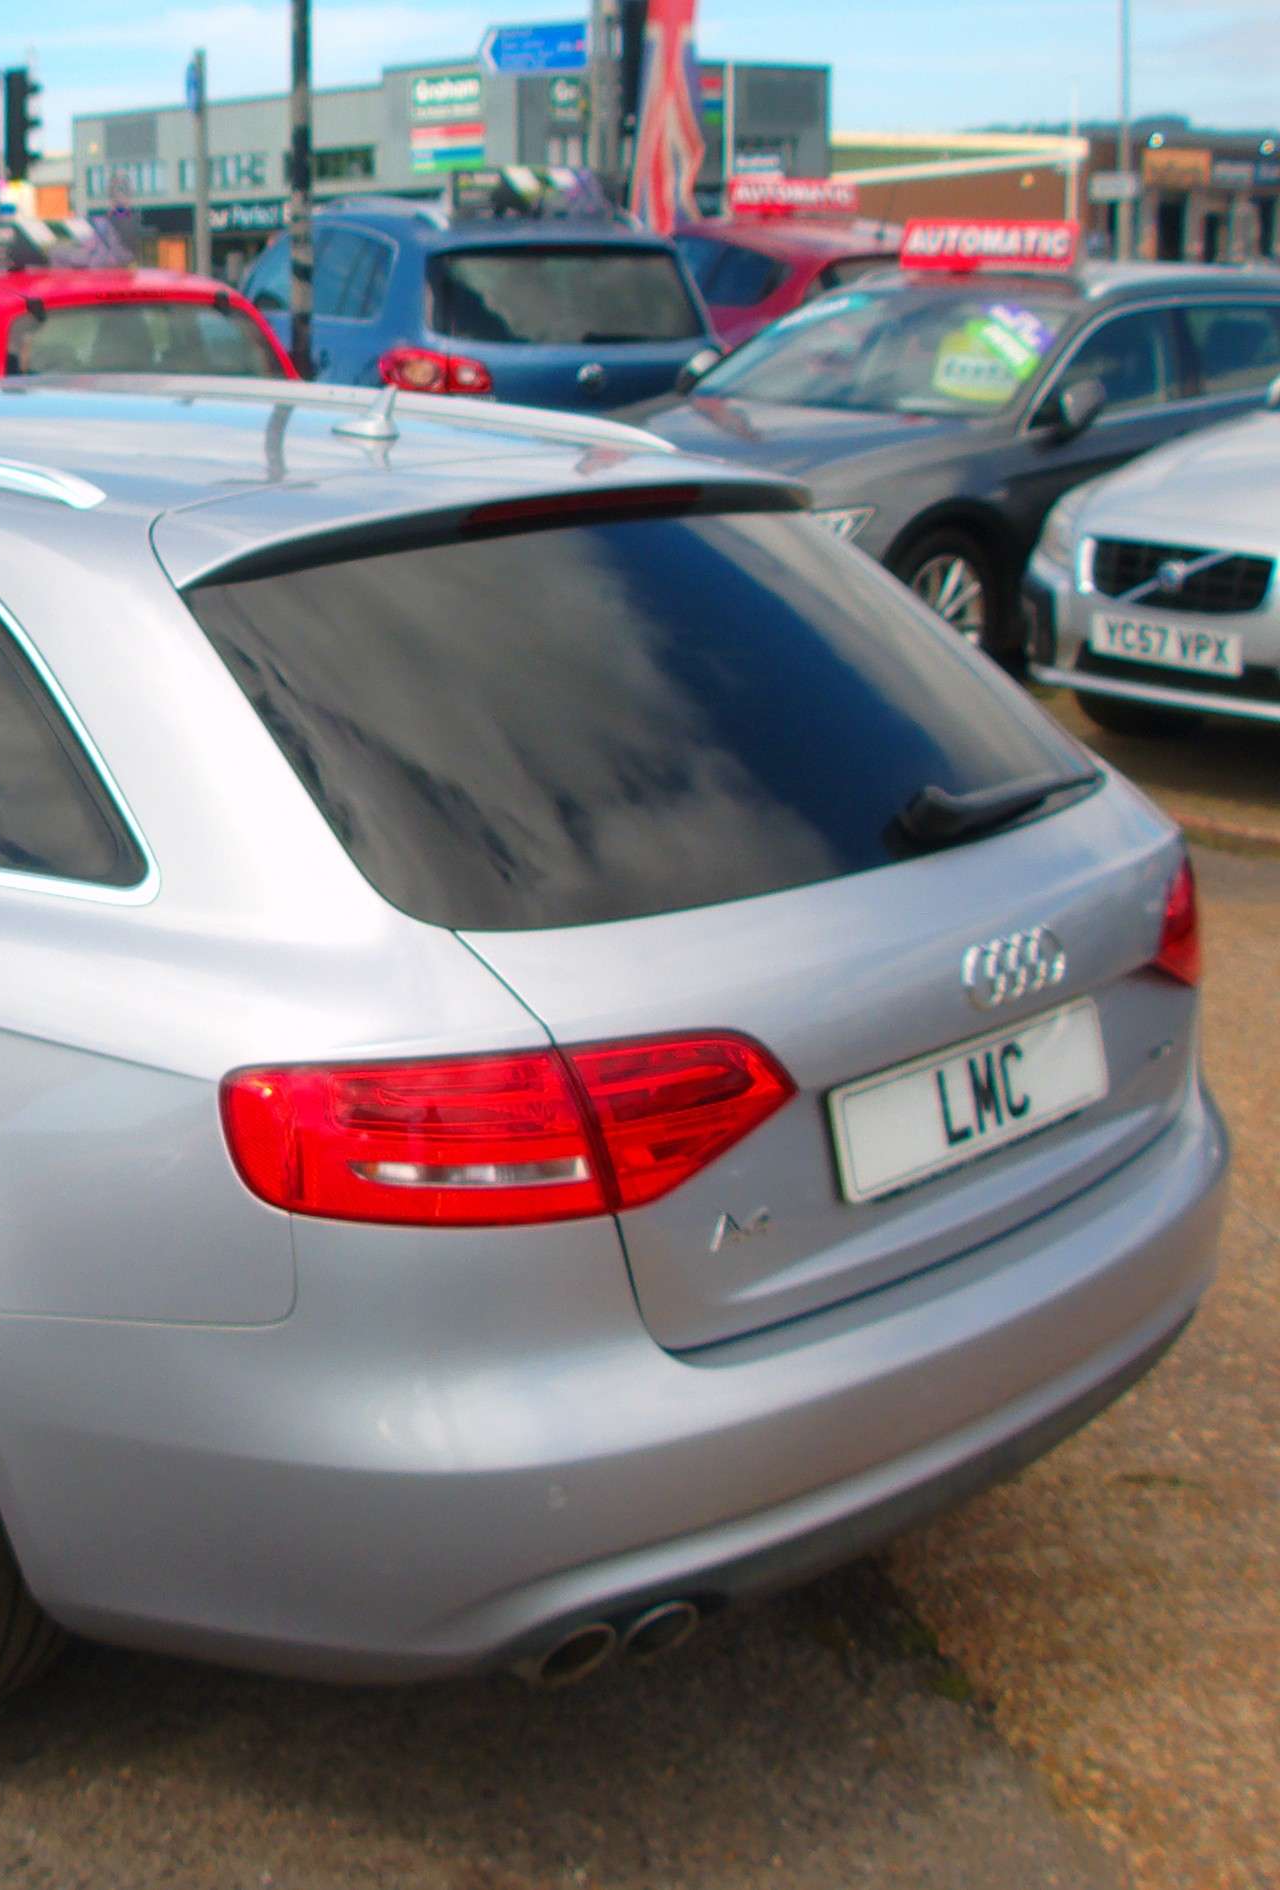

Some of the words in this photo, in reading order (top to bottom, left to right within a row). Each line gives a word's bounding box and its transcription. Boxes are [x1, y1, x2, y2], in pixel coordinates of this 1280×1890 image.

[415, 78, 480, 101] Graham
[734, 181, 854, 204] AUTOMATIC
[906, 224, 1072, 259] AUTOMATIC
[1105, 620, 1170, 657] YC57
[935, 1041, 1030, 1148] LMC
